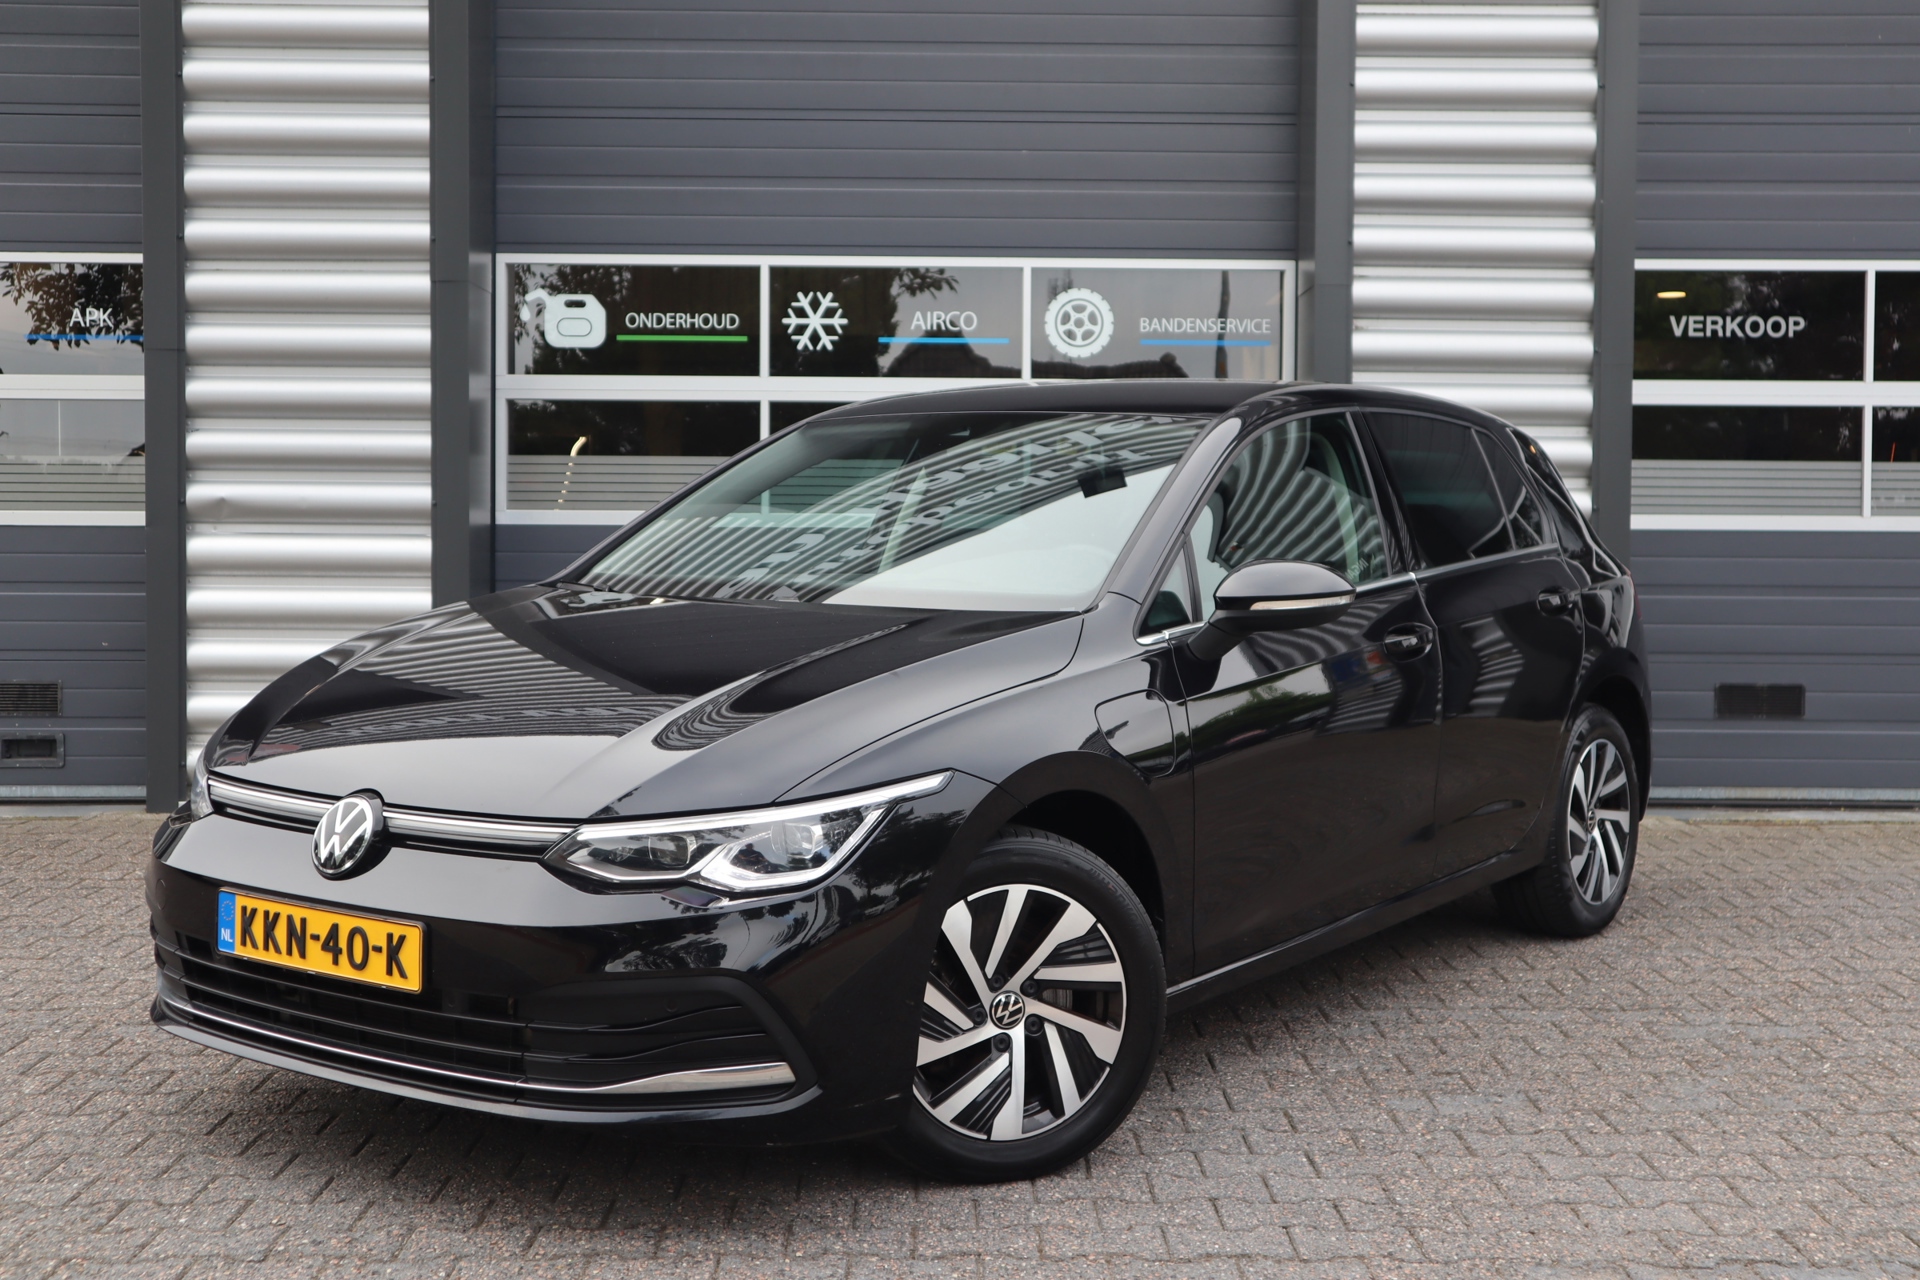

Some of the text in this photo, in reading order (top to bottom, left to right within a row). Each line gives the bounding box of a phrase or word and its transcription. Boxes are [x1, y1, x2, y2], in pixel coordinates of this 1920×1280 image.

[69, 307, 114, 328] APK
[625, 312, 740, 329] ONDERHOUD
[910, 310, 978, 331] AIRCO
[1139, 317, 1272, 333] BANDENSERVICE
[1669, 315, 1806, 338] VERKOOP
[220, 927, 234, 943] NL
[240, 904, 408, 979] KKN-40-K
